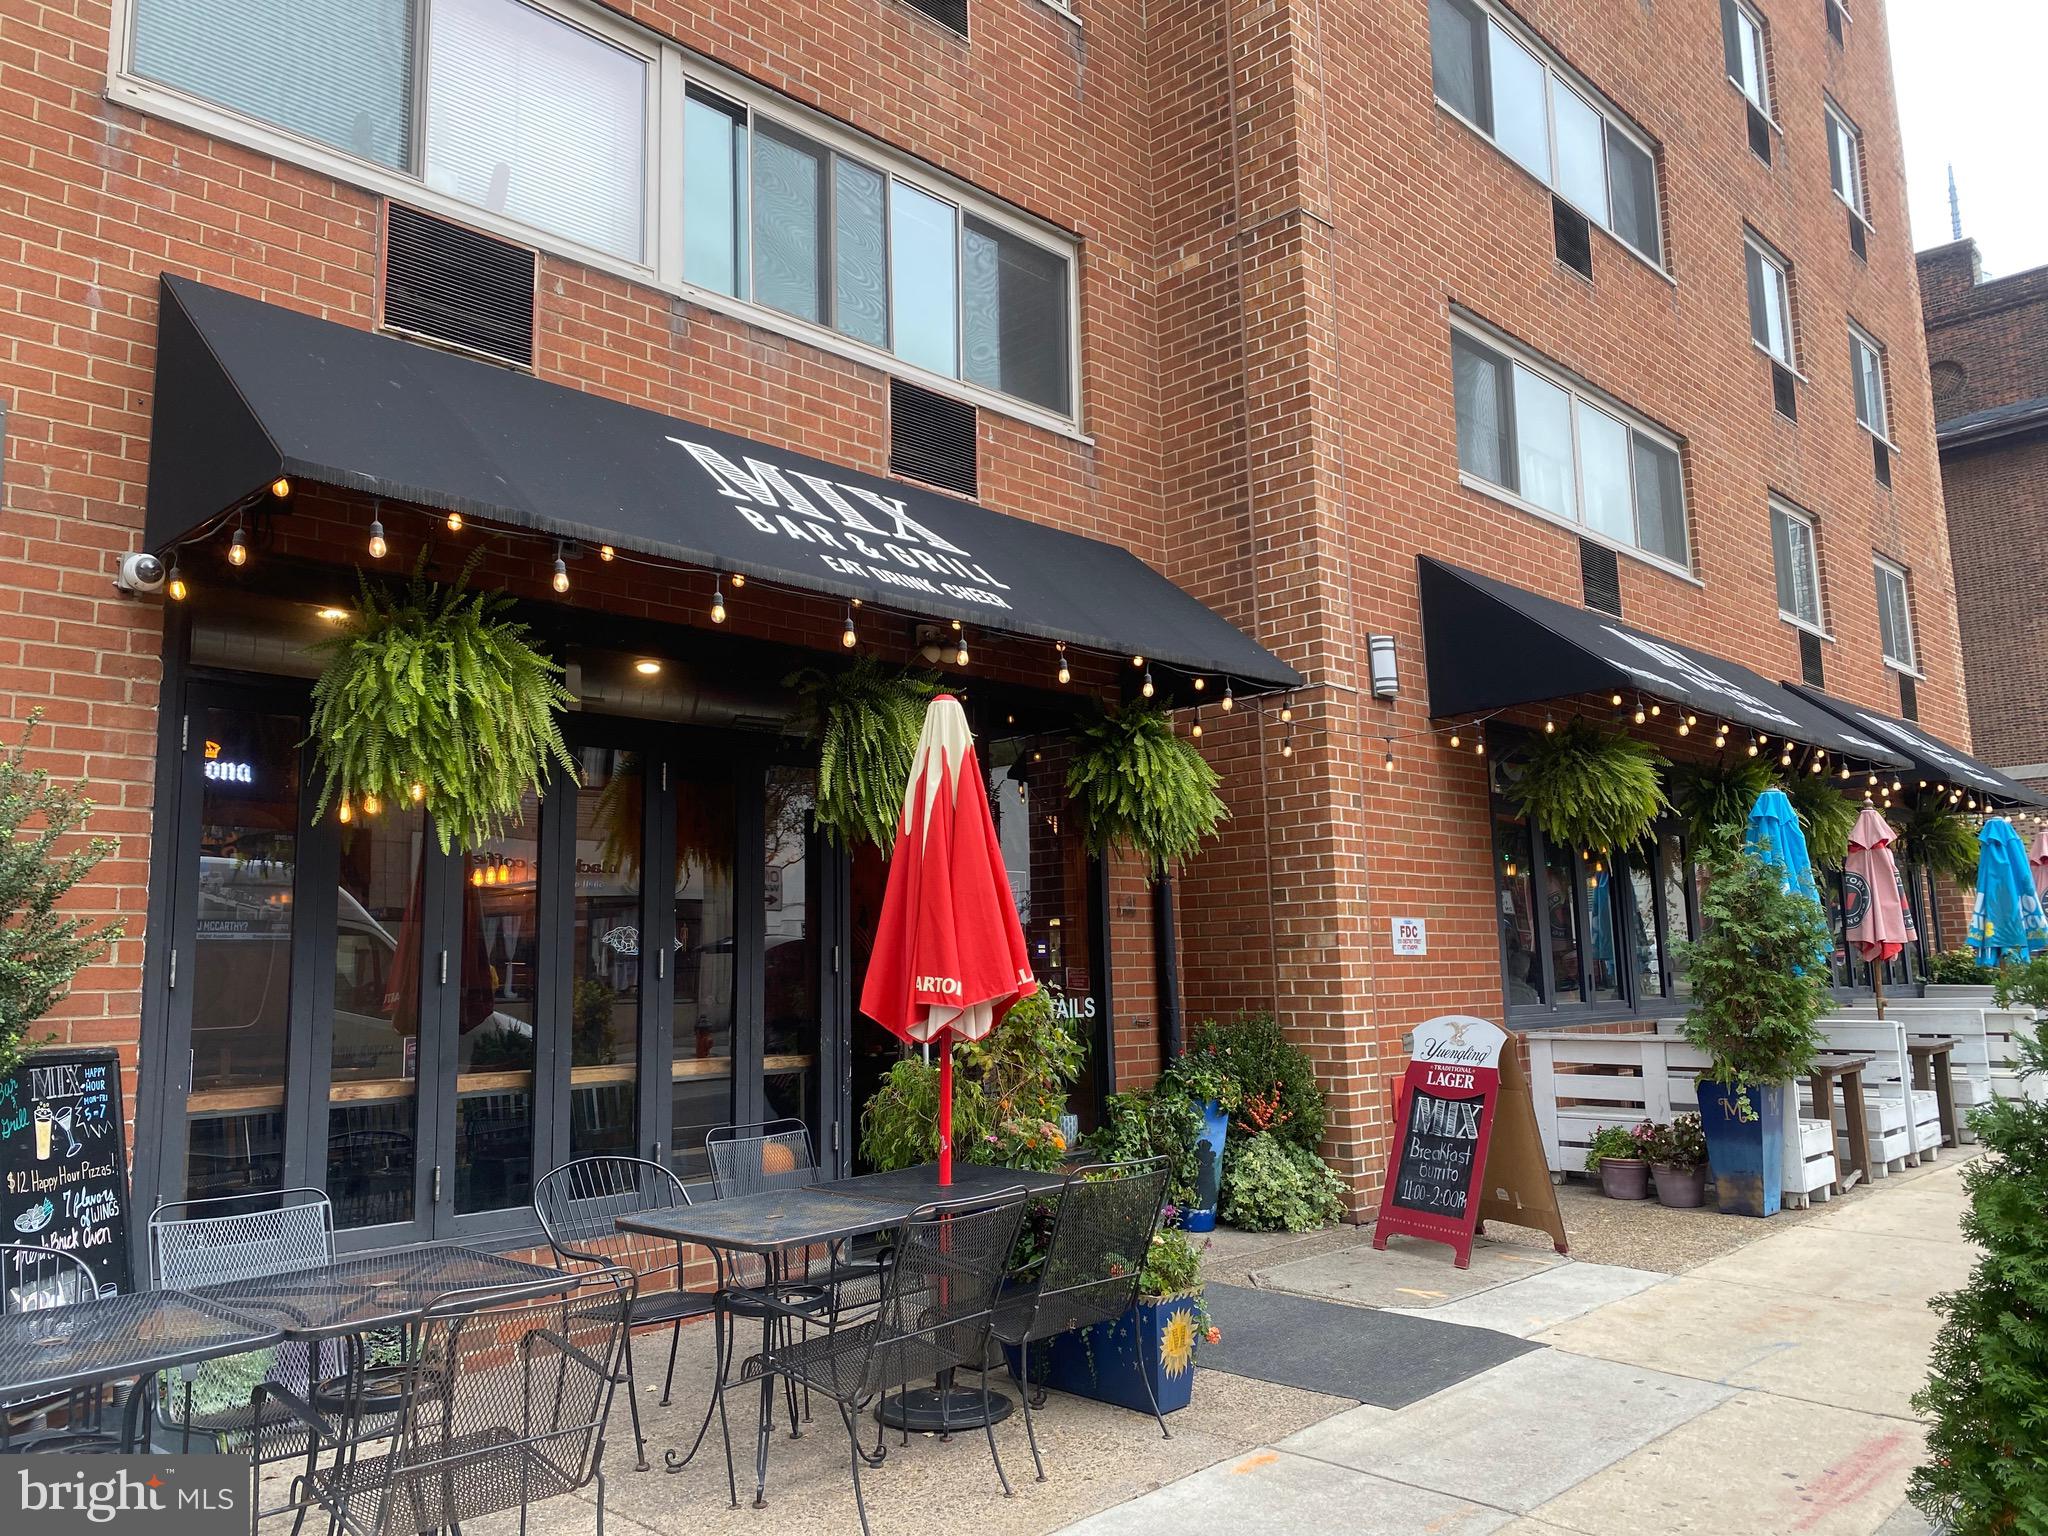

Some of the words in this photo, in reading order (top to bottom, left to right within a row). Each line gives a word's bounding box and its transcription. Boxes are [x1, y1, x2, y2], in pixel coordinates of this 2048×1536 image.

[665, 436, 971, 557] MIX
[735, 505, 848, 551] BAR
[843, 532, 888, 561] &
[883, 543, 1010, 590] GRILL
[820, 555, 870, 578] EAT
[866, 566, 944, 595] DRINK
[941, 583, 1013, 610] CHEER
[204, 921, 249, 931] MCCARTHY?
[1400, 925, 1418, 938] FDC
[1051, 997, 1096, 1018] AILS
[1420, 1037, 1492, 1066] Yuengling
[84, 1067, 106, 1078] HAPPY
[1426, 1071, 1475, 1089] LAGER
[1434, 1064, 1471, 1073] TRADITIONAL
[29, 1064, 84, 1101] MIX
[84, 1080, 106, 1092] HOUR
[83, 1094, 109, 1105] MON-FRI
[2, 1107, 30, 1140] Grill
[1412, 1096, 1484, 1140] MIX
[1410, 1136, 1472, 1166] Breakfast
[7, 1170, 29, 1194] $12
[31, 1169, 58, 1193] Happy
[58, 1165, 80, 1185] Hour
[1420, 1161, 1459, 1182] Burrito
[63, 1189, 71, 1218] 7
[90, 1200, 119, 1223] WINGS
[50, 1226, 79, 1250] Brick
[83, 1226, 112, 1248] Oven
